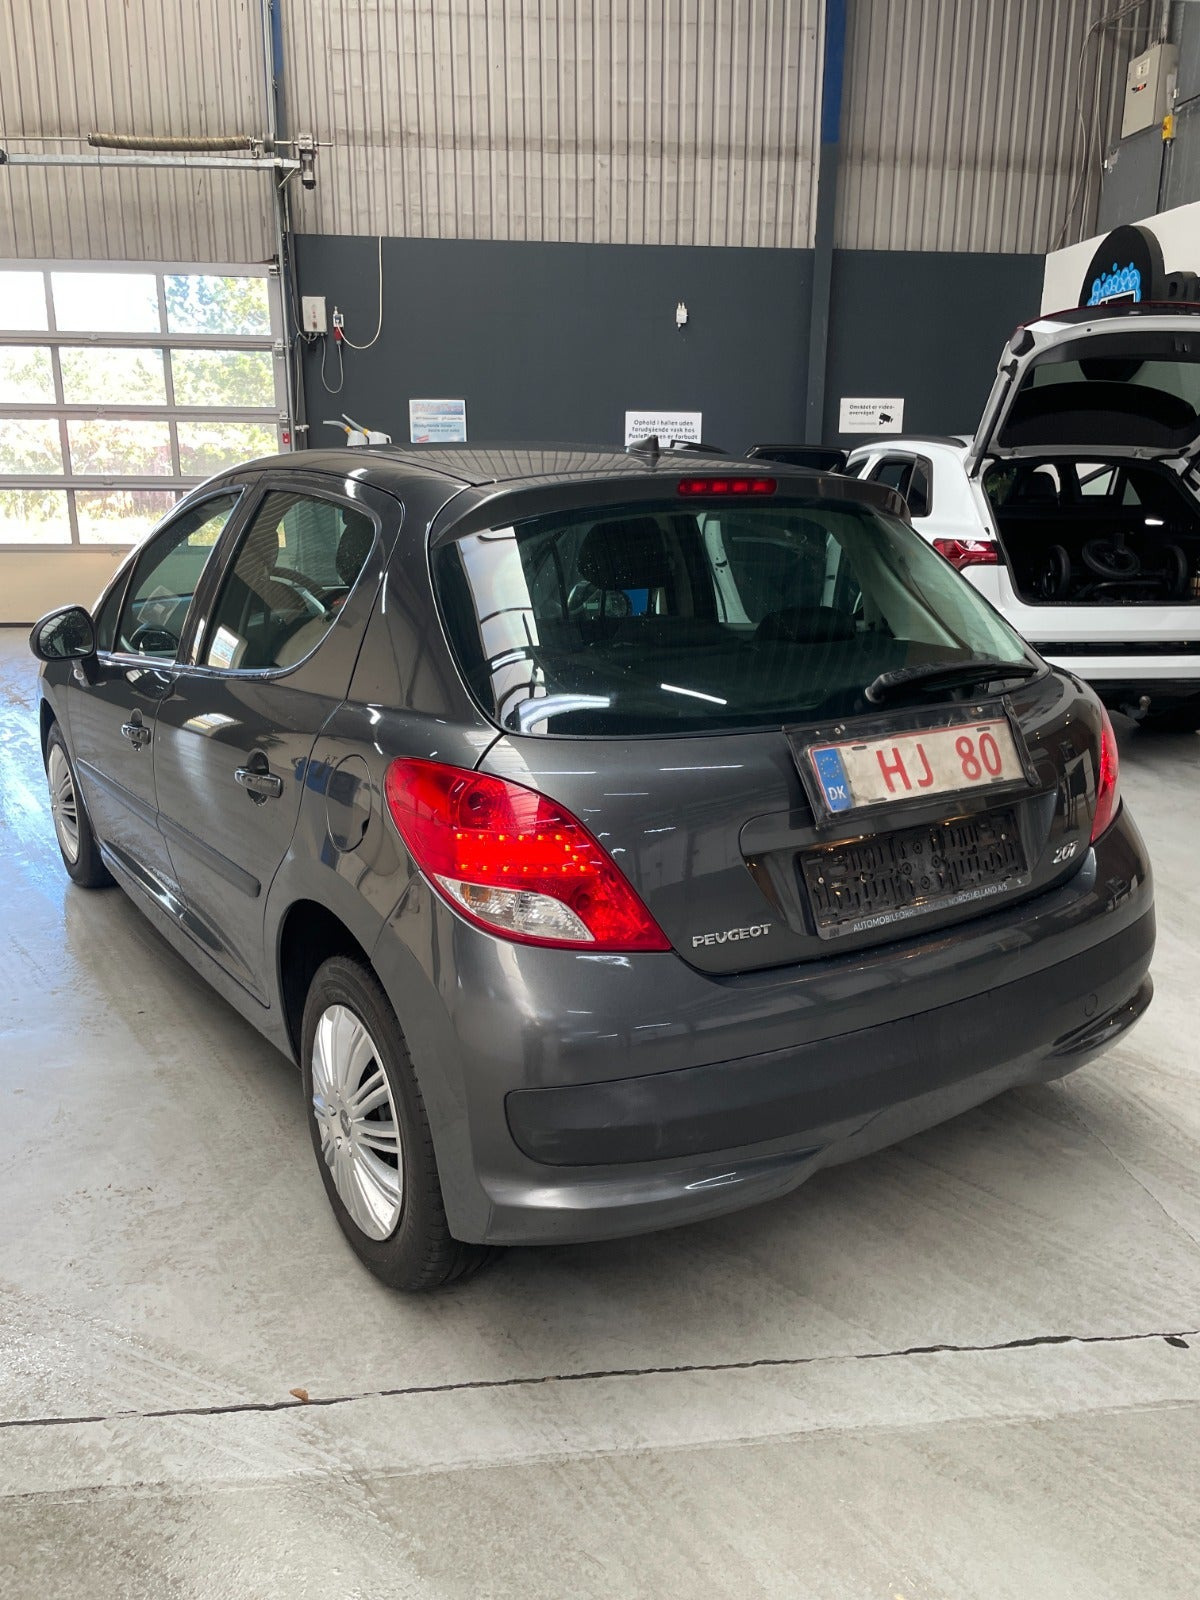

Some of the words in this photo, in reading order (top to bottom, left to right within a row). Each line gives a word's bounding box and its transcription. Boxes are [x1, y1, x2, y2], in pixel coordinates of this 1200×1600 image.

[876, 743, 933, 793] HJ
[955, 733, 1002, 781] 80
[828, 785, 847, 801] DK
[1052, 840, 1079, 864] 207
[692, 923, 772, 948] PEUGEOT
